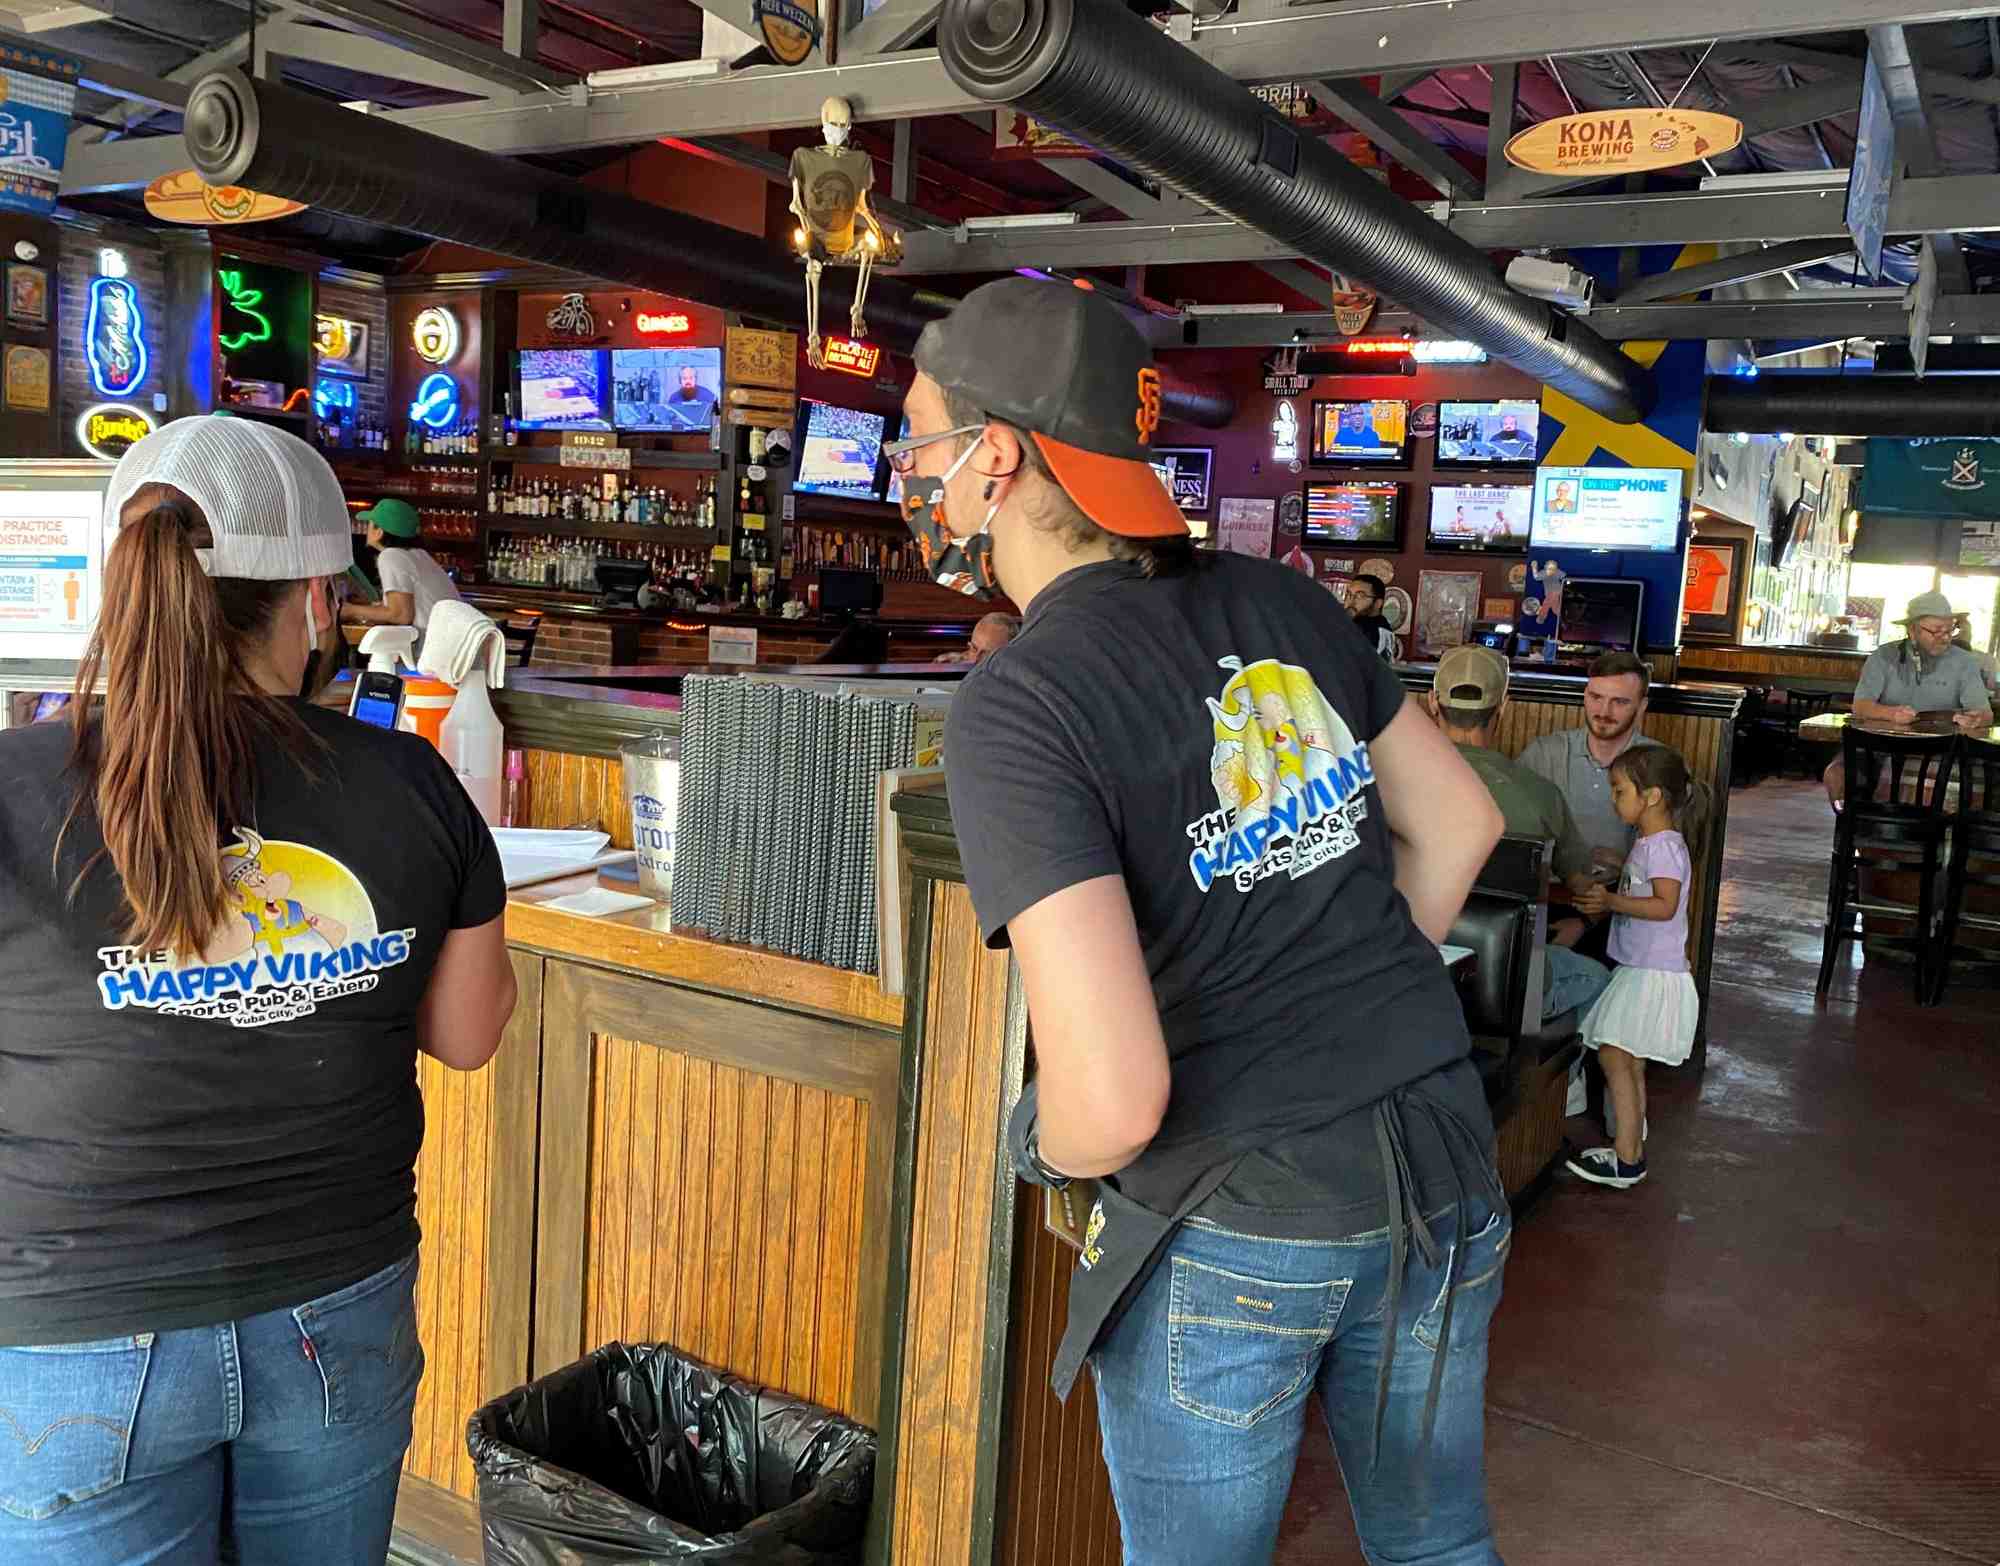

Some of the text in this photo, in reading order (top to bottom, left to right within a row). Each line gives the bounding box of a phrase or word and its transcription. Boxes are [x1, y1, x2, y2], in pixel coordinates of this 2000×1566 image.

[1559, 119, 1634, 144] KONA
[1557, 141, 1634, 158] BREWING
[830, 341, 874, 359] NEWCASTLE
[857, 358, 873, 370] ALE
[1264, 376, 1288, 389] SMALL
[1173, 479, 1202, 495] NESS
[1619, 479, 1668, 492] PHONE
[3, 520, 63, 532] PRACTICE
[0, 576, 28, 585] NTAIN
[1191, 806, 1238, 842] THE
[1328, 817, 1344, 833] &
[102, 948, 167, 968] THE
[103, 959, 259, 1006] HAPPY
[263, 933, 407, 984] VIKING
[245, 992, 284, 1010] Pub
[292, 989, 306, 1001] &
[313, 976, 376, 999] Eatery
[235, 1014, 266, 1025] Yuba
[296, 1004, 312, 1014] CA
